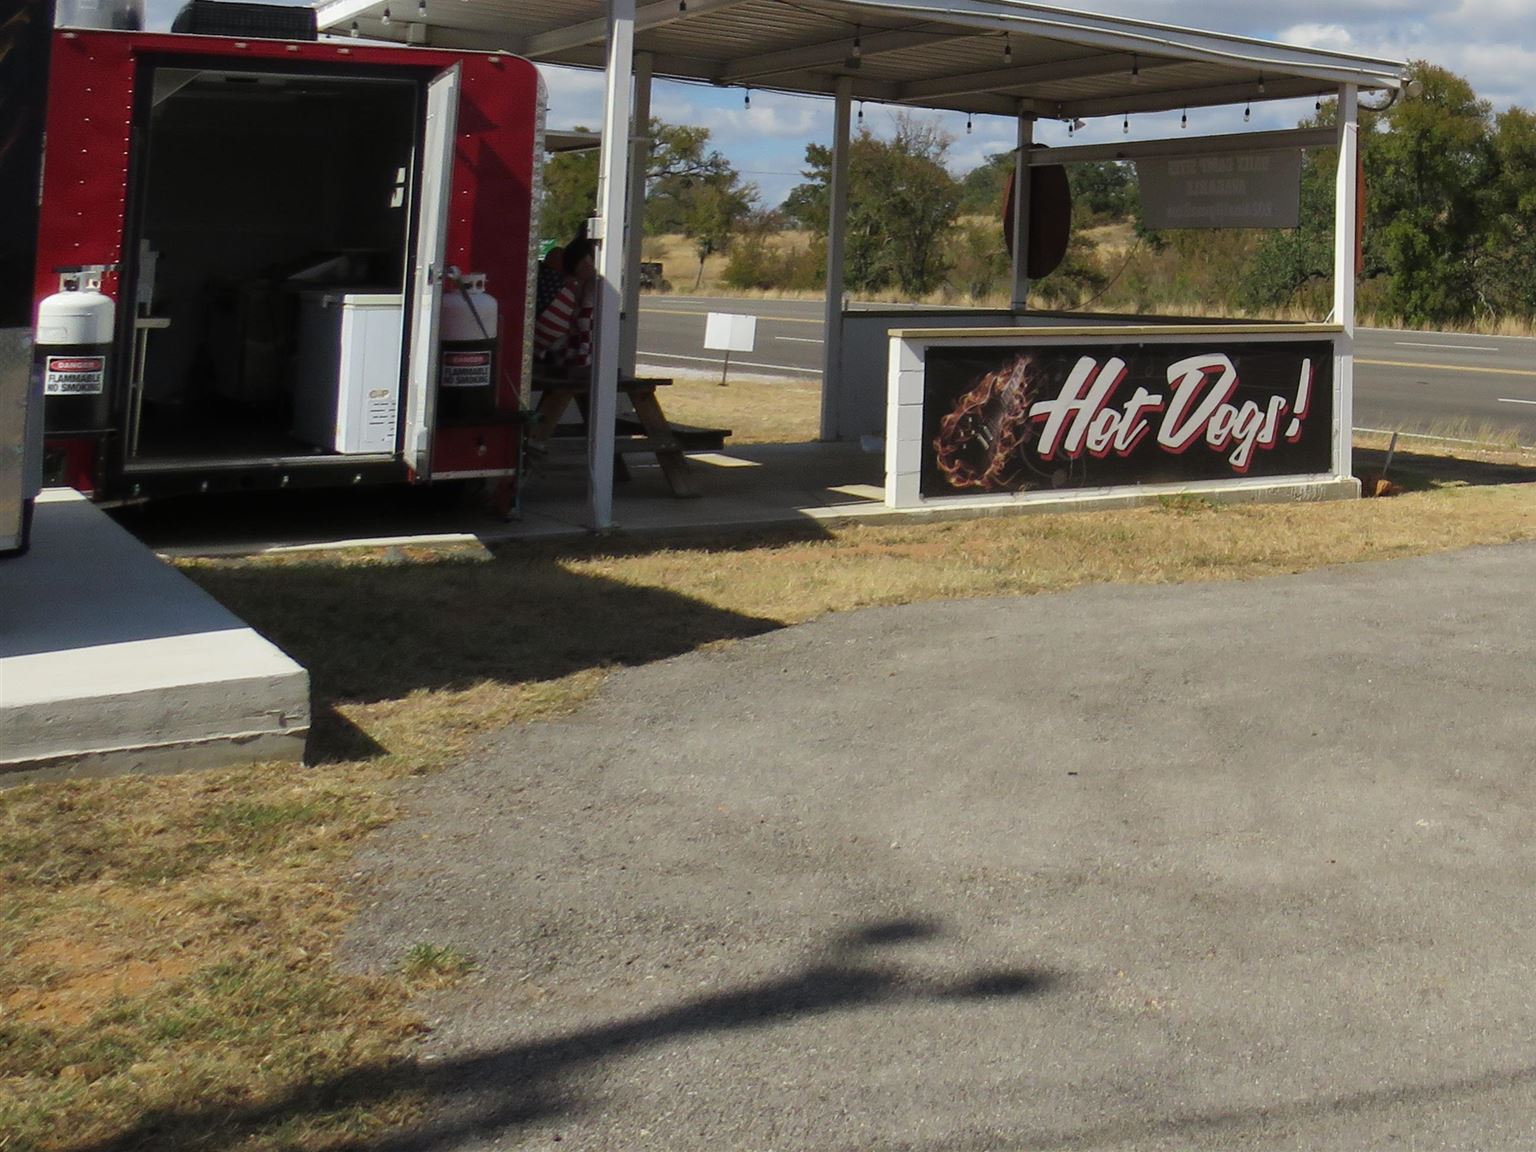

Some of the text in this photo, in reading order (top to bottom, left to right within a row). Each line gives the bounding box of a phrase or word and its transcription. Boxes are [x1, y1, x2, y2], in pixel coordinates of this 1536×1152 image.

[48, 374, 102, 383] FLAMMABLE
[47, 383, 102, 392] NO SMOKING
[1029, 353, 1315, 472] Hot Dogs!
